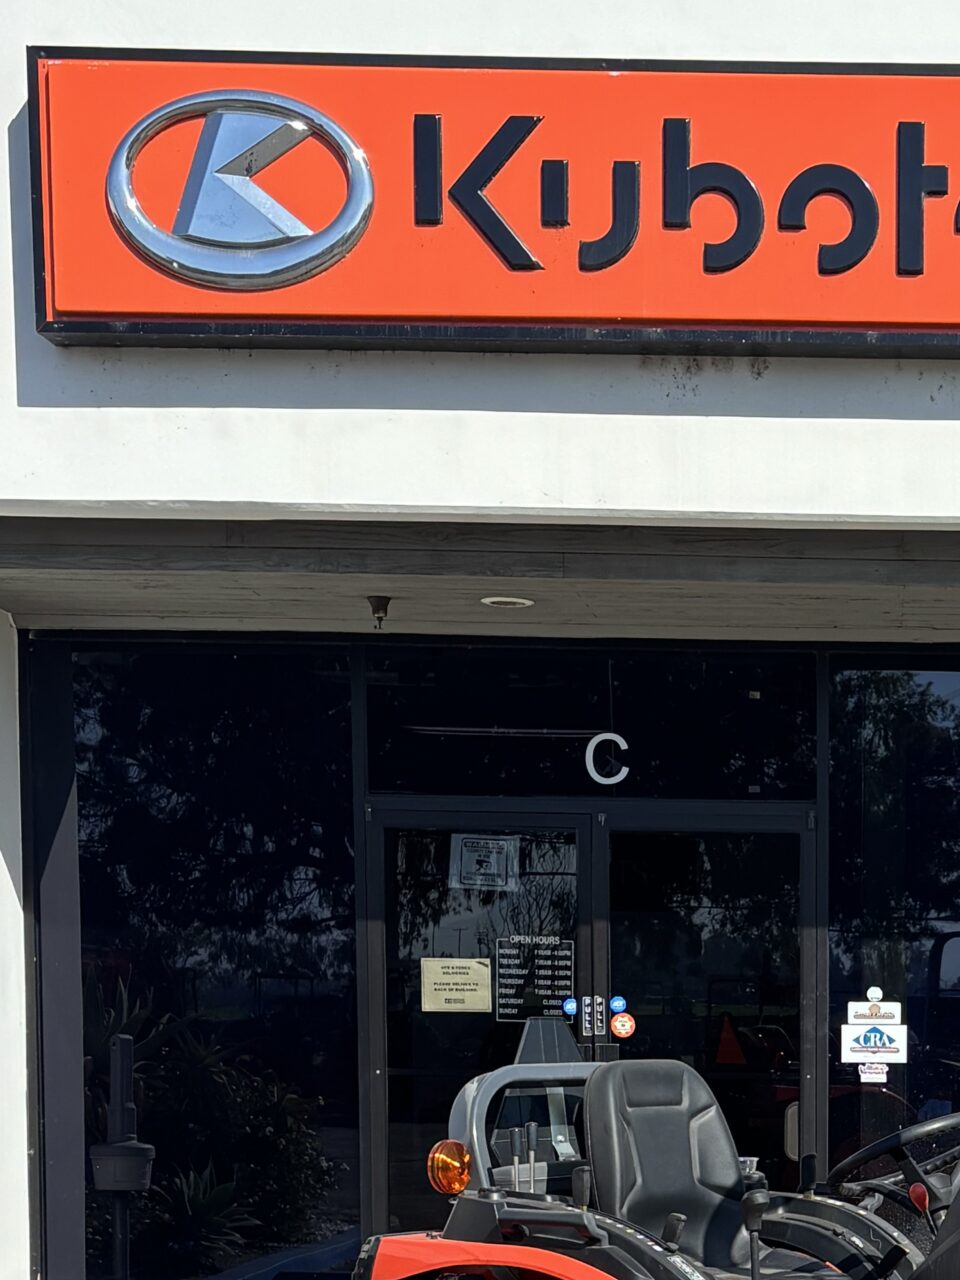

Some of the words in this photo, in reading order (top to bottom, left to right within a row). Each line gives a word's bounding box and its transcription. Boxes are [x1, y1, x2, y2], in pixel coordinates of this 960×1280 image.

[585, 732, 630, 785] C
[510, 935, 531, 944] OPEN
[533, 935, 560, 945] HOURS
[860, 1032, 890, 1048] CRA
